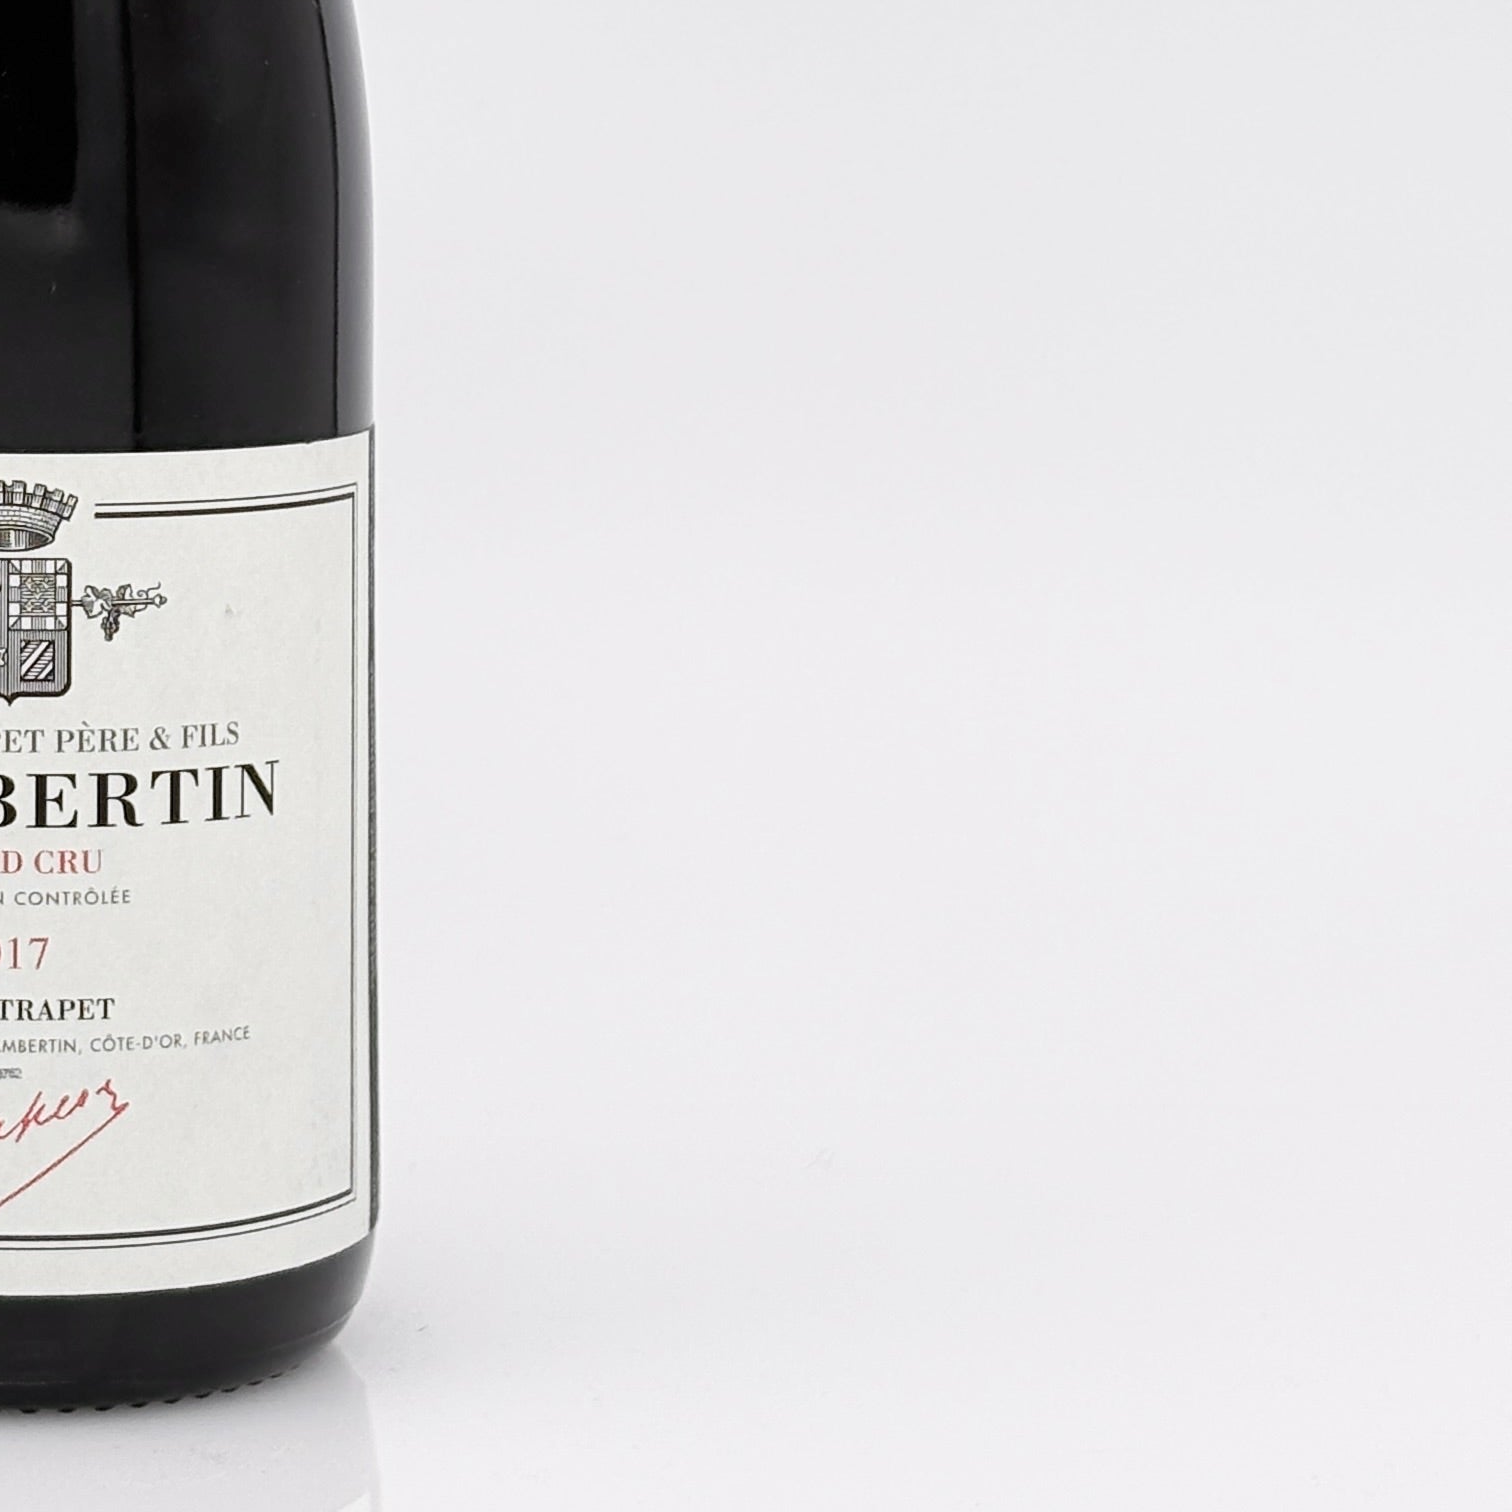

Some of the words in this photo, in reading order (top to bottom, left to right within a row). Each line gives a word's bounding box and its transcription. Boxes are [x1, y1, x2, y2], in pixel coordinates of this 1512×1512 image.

[55, 720, 140, 754] PÈRE
[148, 726, 171, 751] &
[181, 720, 240, 750] FILS
[33, 849, 104, 875] CRU
[13, 886, 132, 907] CONTRÔLÉE
[89, 1033, 187, 1053] CÔTE-D'OR,
[194, 1025, 251, 1046] FRANCE
